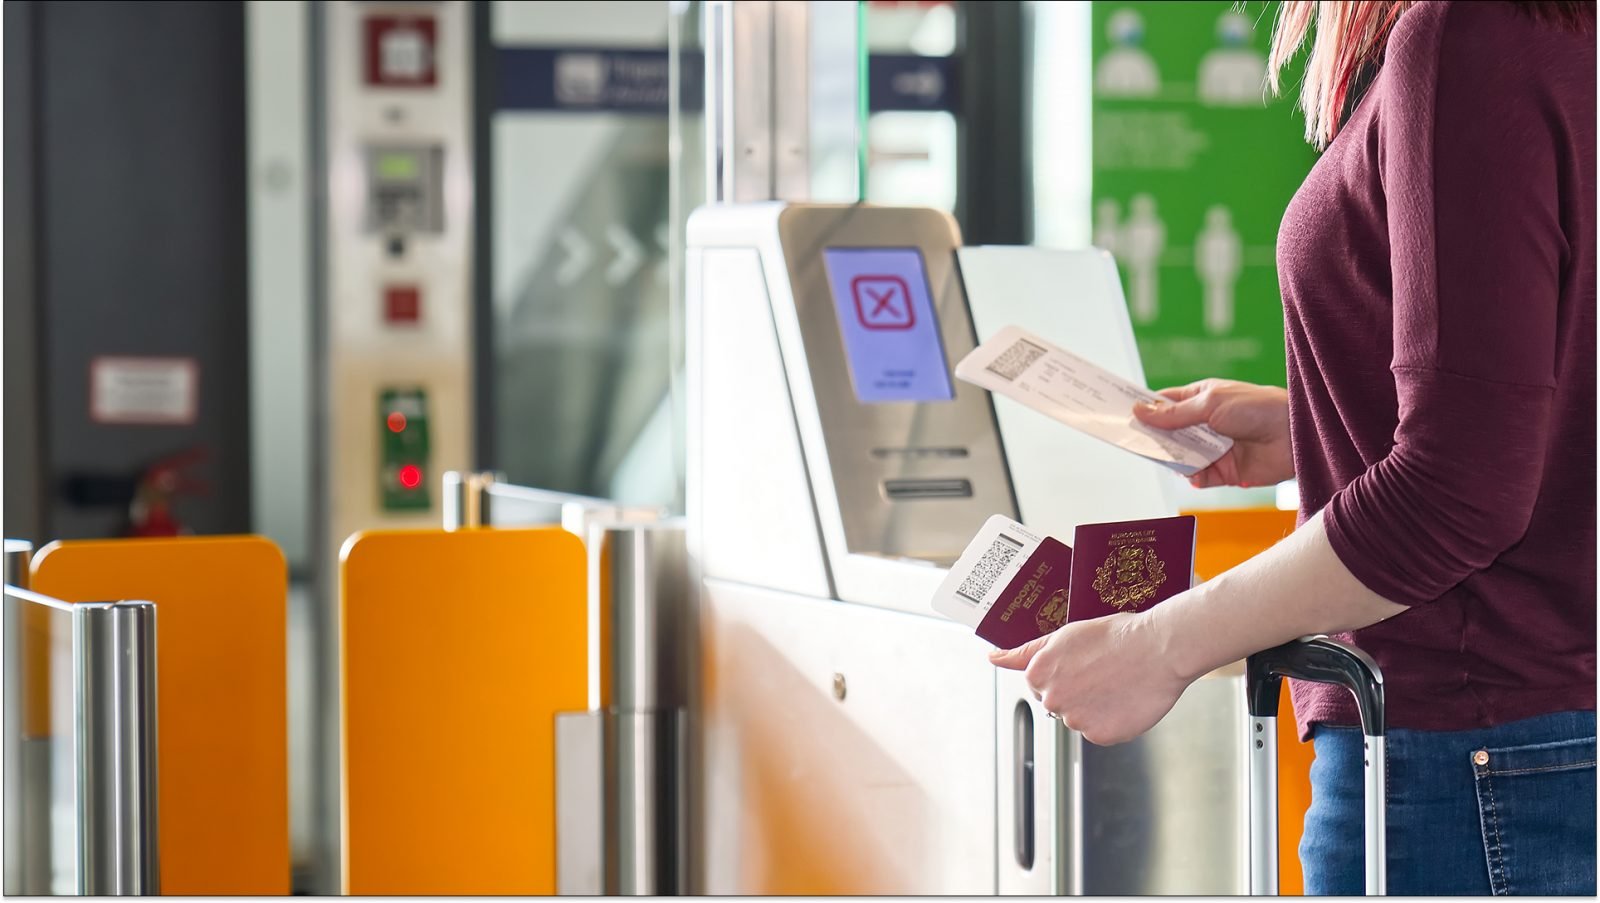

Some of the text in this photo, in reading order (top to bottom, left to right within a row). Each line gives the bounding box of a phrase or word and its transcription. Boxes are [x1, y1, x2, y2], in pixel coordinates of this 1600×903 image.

[1000, 580, 1037, 621] EUROOPA
[1033, 562, 1048, 579] LIIT
[1023, 584, 1045, 609] EESTI
